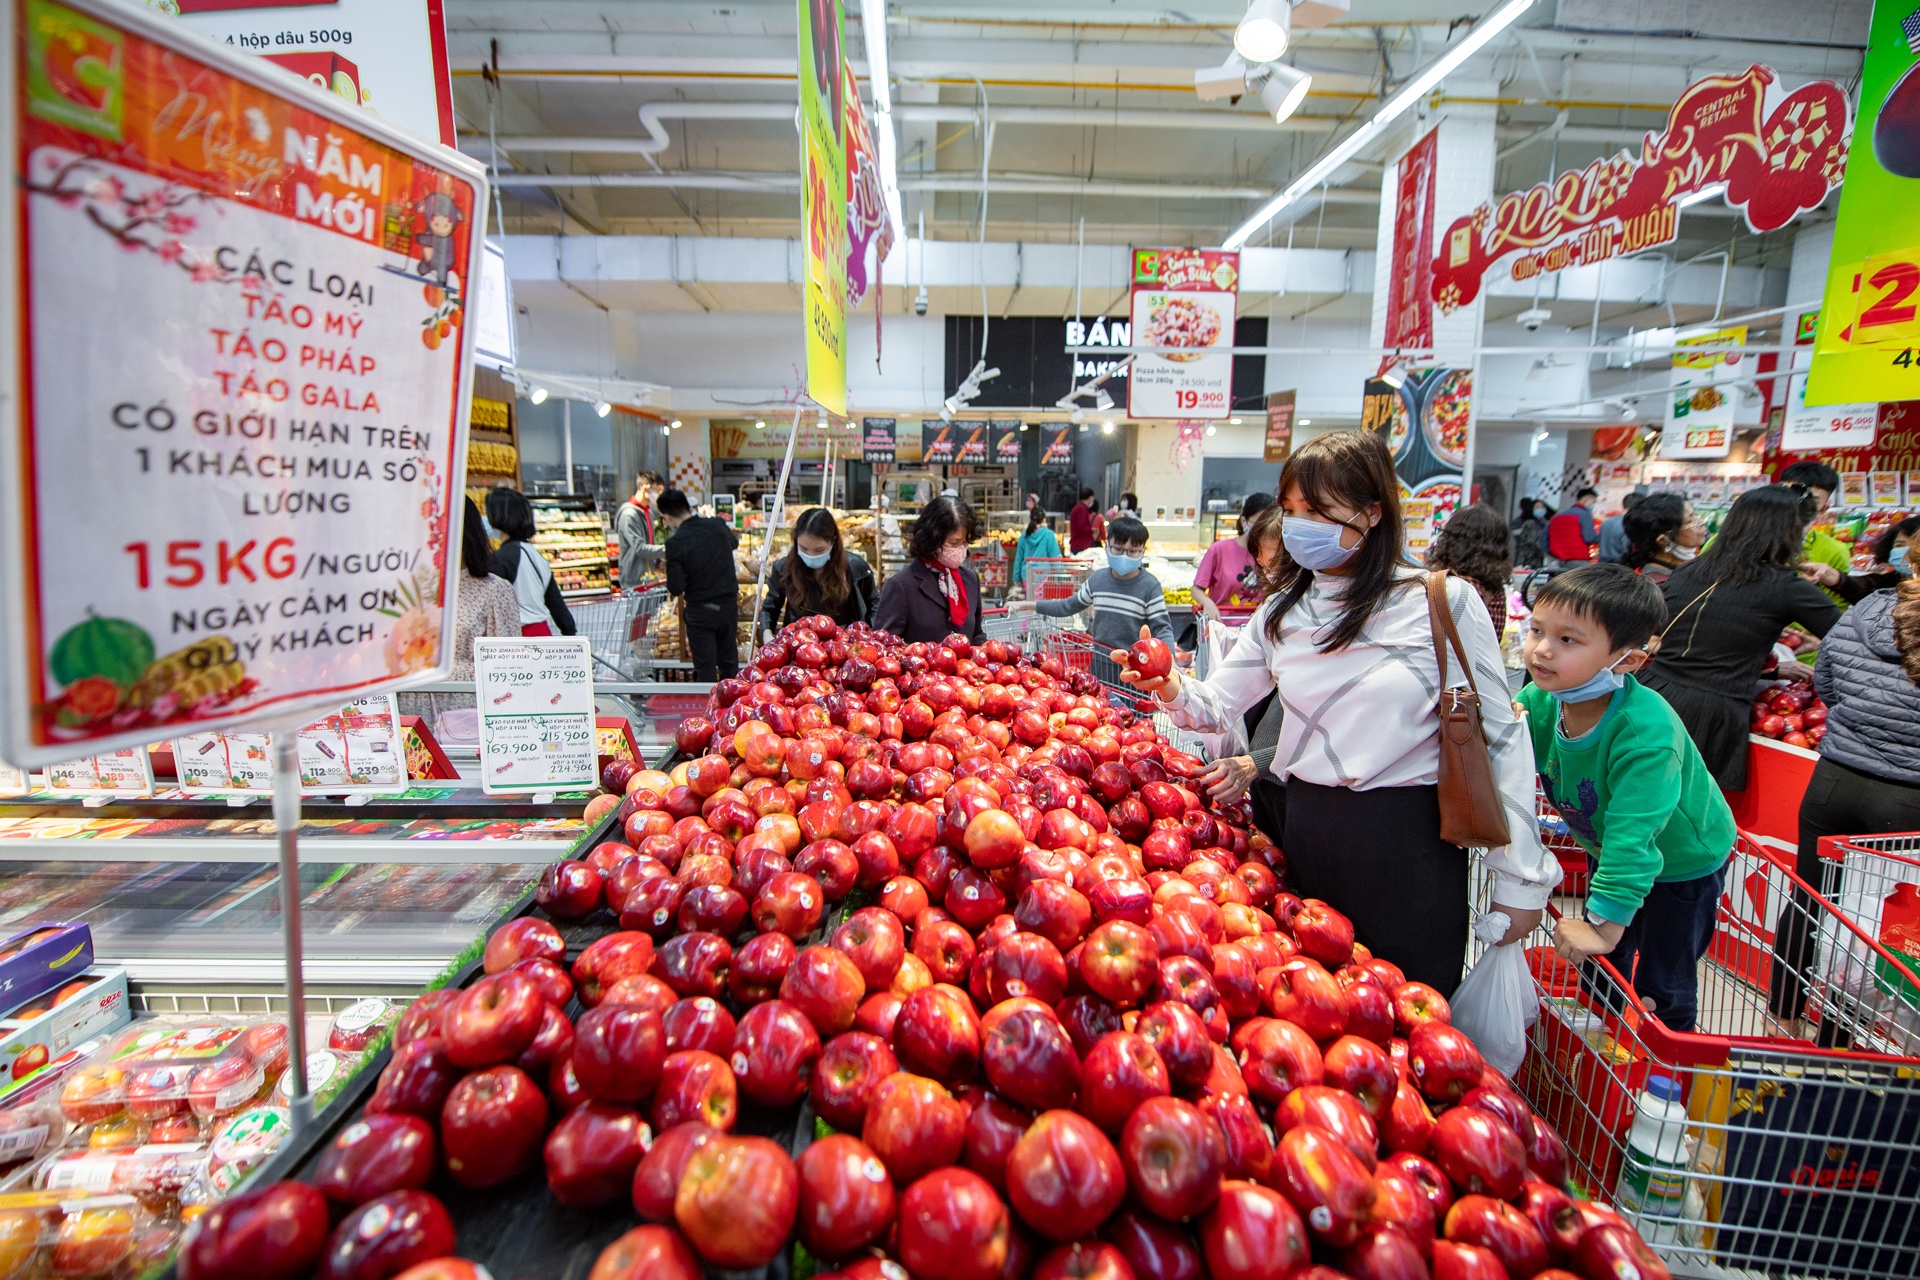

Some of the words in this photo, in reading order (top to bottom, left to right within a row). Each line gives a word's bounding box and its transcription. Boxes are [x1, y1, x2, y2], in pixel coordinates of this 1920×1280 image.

[240, 34, 270, 49] hộp
[275, 31, 304, 45] dâu
[309, 29, 353, 45] 500g
[1693, 87, 1747, 121] CENTRAL
[1699, 103, 1738, 131] RETAIL
[284, 127, 382, 196] NĂM
[295, 184, 375, 240] MỚI
[1486, 163, 1602, 256] 2021
[1544, 241, 1575, 272] CHÚC
[1579, 224, 1613, 266] TÂN
[1618, 203, 1676, 254] XUÂN
[214, 245, 294, 286] CÁC
[308, 268, 374, 308] LOẠI
[209, 328, 287, 363] TÁO
[300, 345, 376, 376] PHÁP
[213, 368, 290, 400] TÁO
[301, 382, 381, 413] GALA
[1207, 378, 1222, 387] vnd
[111, 398, 176, 433] CÓ
[193, 410, 277, 441] GIỚI
[289, 421, 350, 446] HẠN
[363, 424, 431, 451] TRÊN
[134, 448, 151, 474] 1
[168, 445, 296, 478] KHÁCH
[306, 457, 372, 481] MUA
[382, 456, 418, 482] SỐ
[243, 489, 351, 518] LƯỢNG
[171, 599, 272, 634] NGÀY
[185, 639, 261, 670] QUÝ
[270, 622, 375, 654] KHÁCH
[488, 671, 534, 683] 199.900
[539, 669, 586, 680] 375.900
[487, 743, 537, 754] 169.900
[540, 731, 589, 742] 215.900
